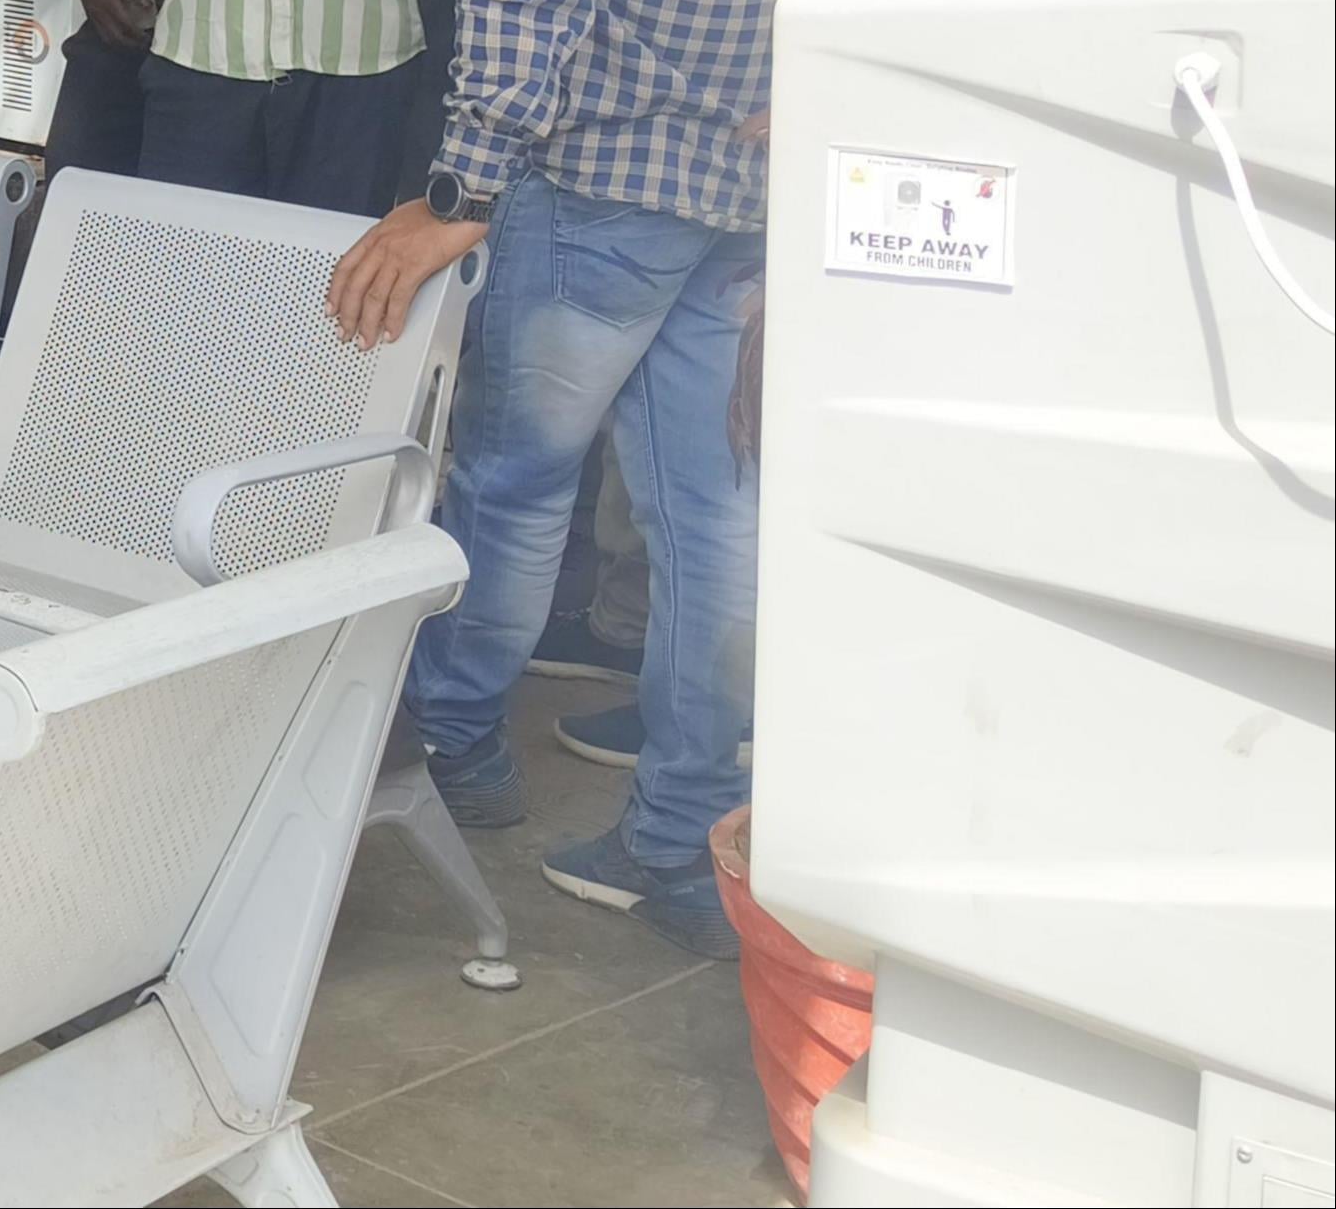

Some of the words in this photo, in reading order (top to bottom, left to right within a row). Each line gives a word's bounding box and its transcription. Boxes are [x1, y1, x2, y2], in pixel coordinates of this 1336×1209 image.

[849, 231, 913, 251] KEEP
[921, 239, 989, 259] AWAY
[866, 250, 904, 266] FROM
[908, 254, 973, 273] CHILDREN
